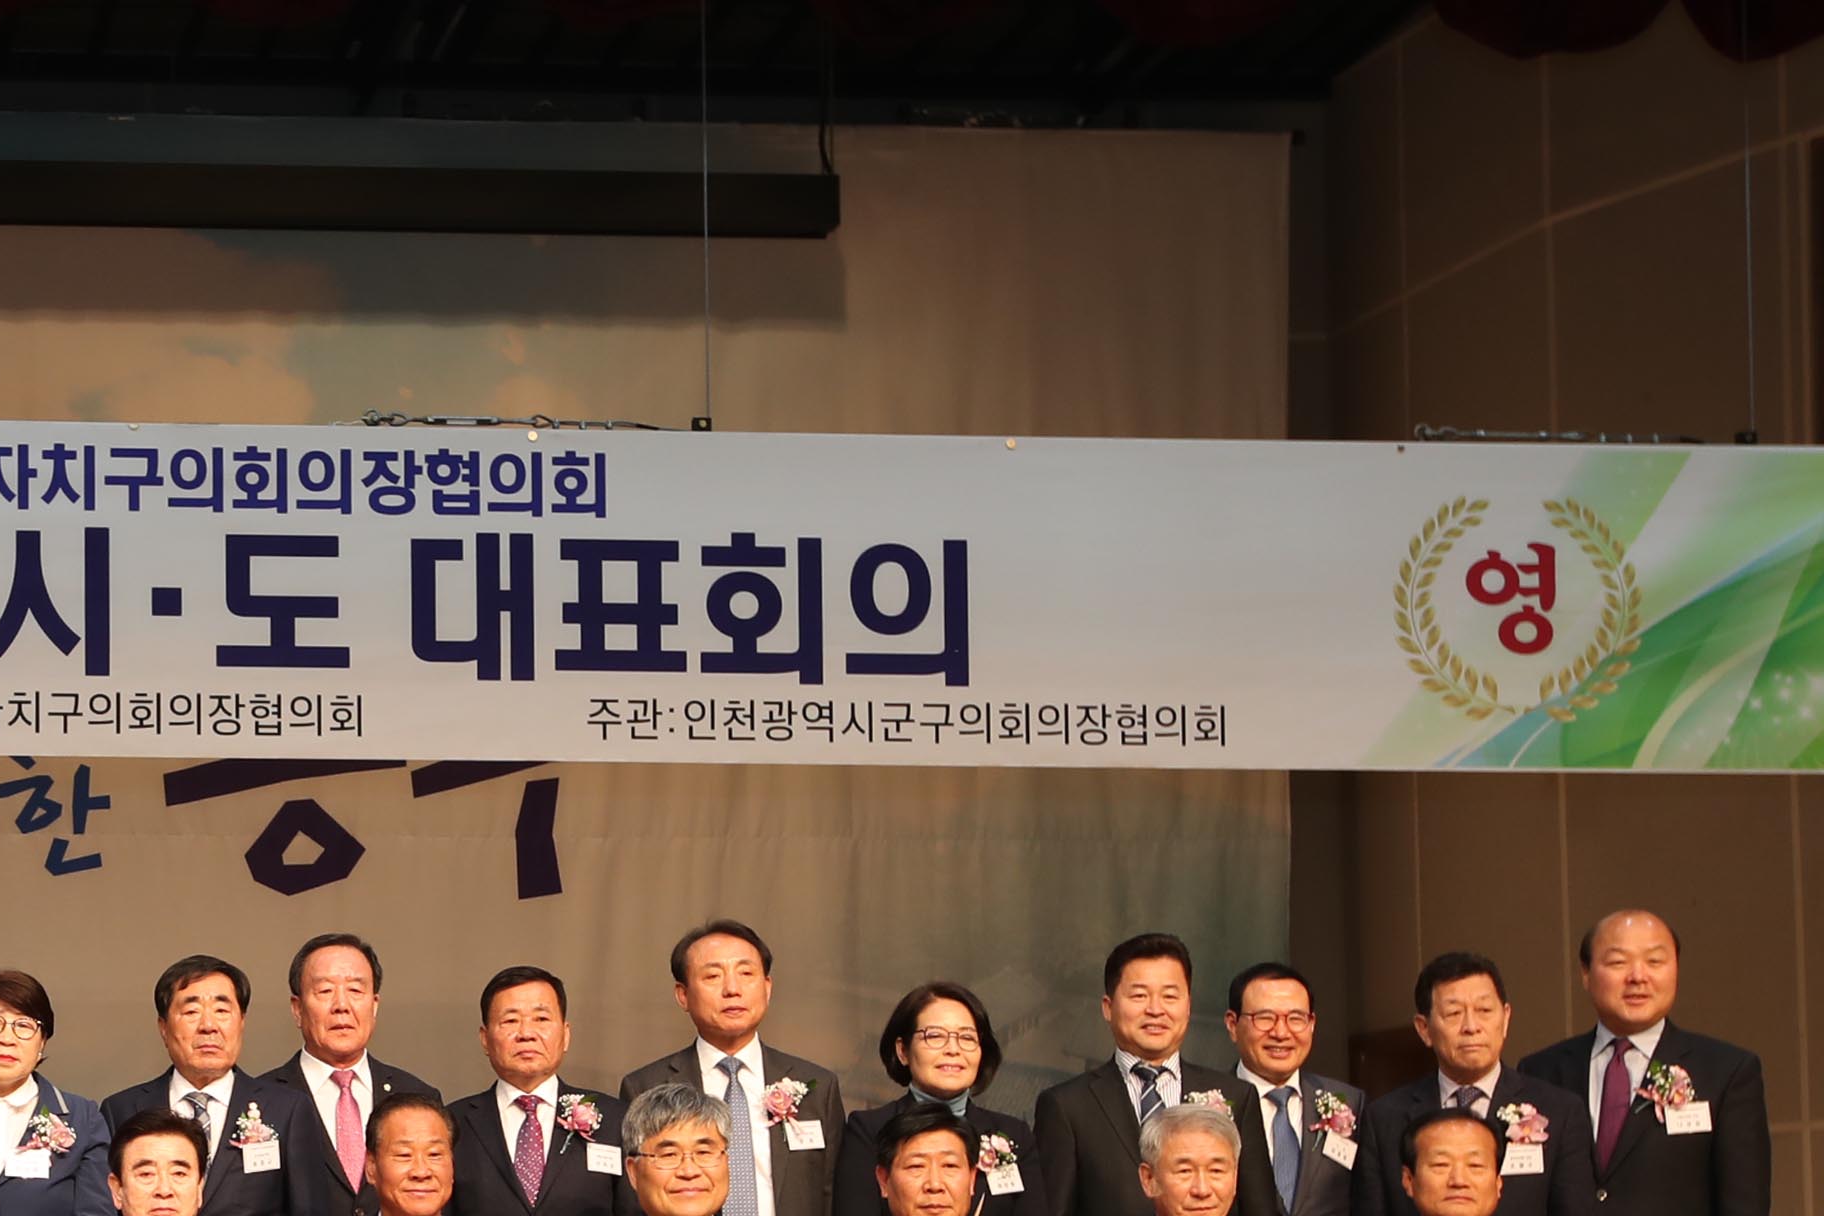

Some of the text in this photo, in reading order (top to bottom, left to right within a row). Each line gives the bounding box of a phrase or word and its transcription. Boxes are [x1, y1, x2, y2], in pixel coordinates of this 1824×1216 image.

[410, 531, 970, 687] 대표회의
[1466, 543, 1556, 654] 영
[586, 698, 1228, 747] 주관:인천광역시군구의회의장협의회
